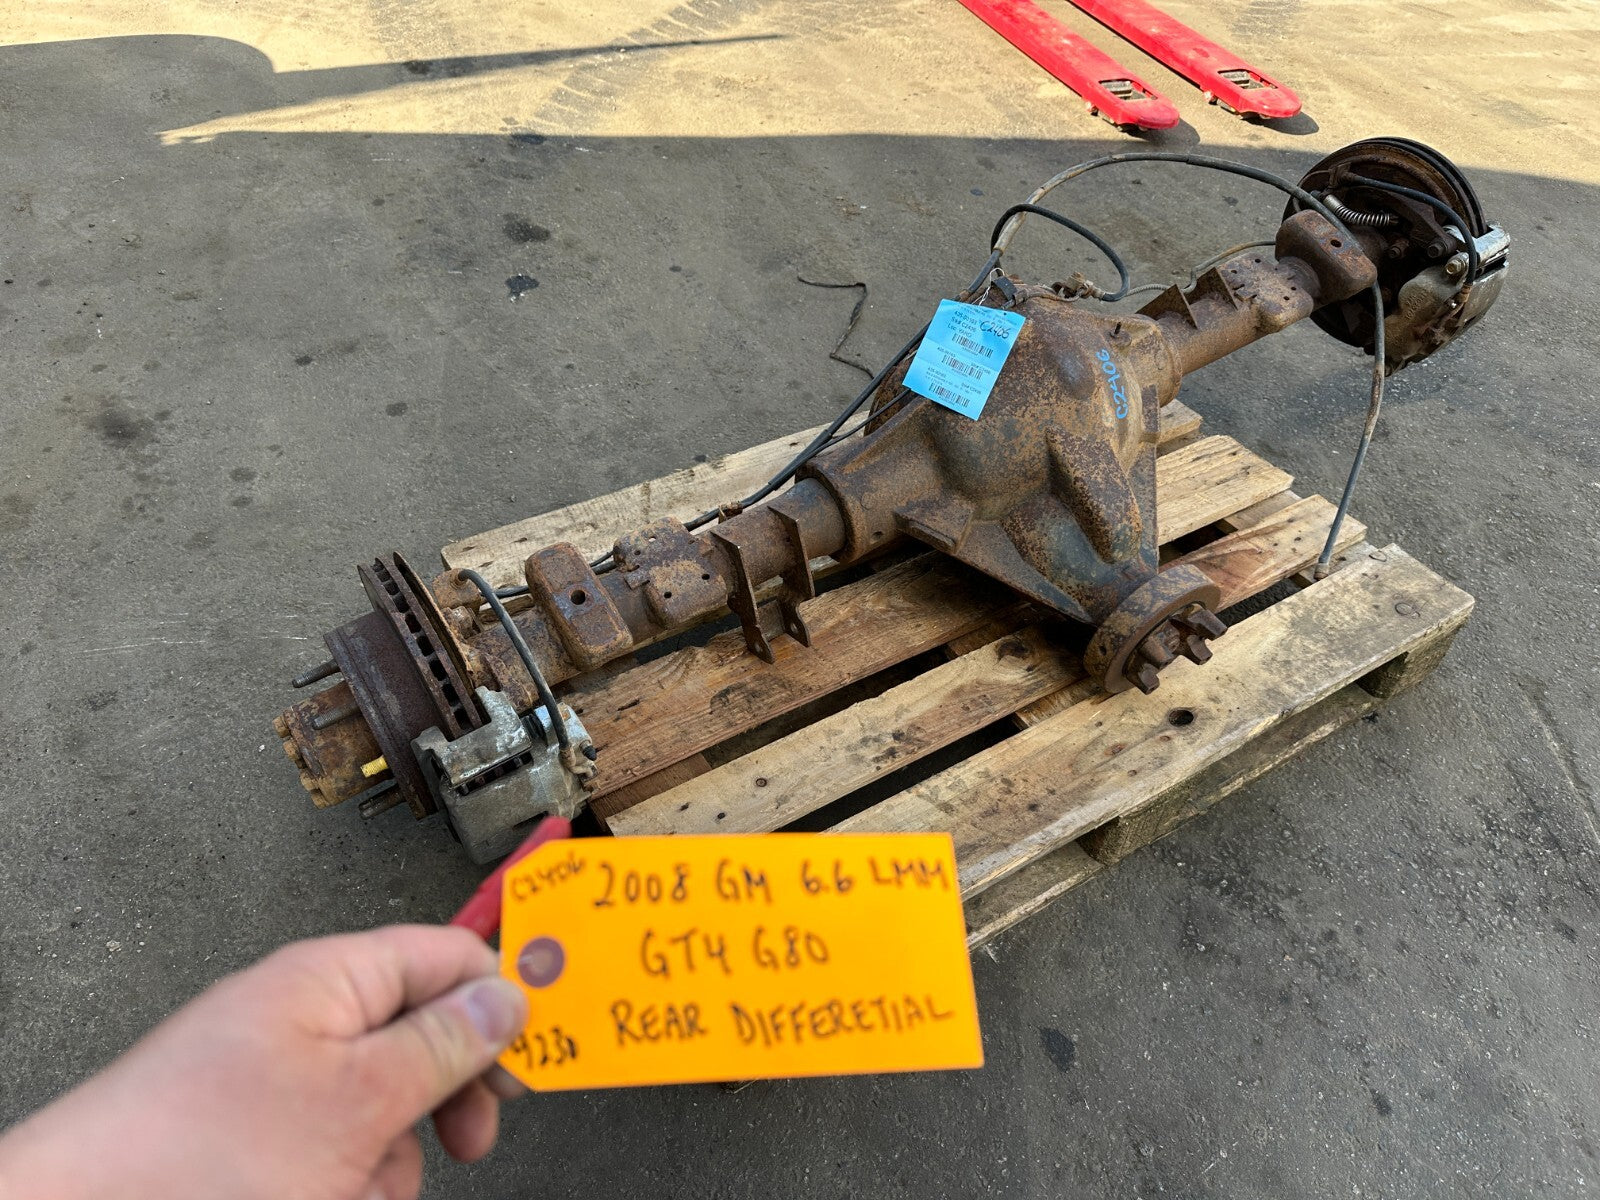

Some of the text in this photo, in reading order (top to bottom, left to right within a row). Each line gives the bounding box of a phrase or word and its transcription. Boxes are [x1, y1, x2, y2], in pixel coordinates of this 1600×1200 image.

[980, 320, 1011, 339] C2406
[1095, 348, 1128, 419] C2406
[593, 860, 690, 908] 2008
[715, 859, 773, 904] GM
[867, 856, 952, 892] LMM
[640, 926, 831, 978] GT4 G80
[610, 994, 958, 1048] REAR DIFFERETIAL
